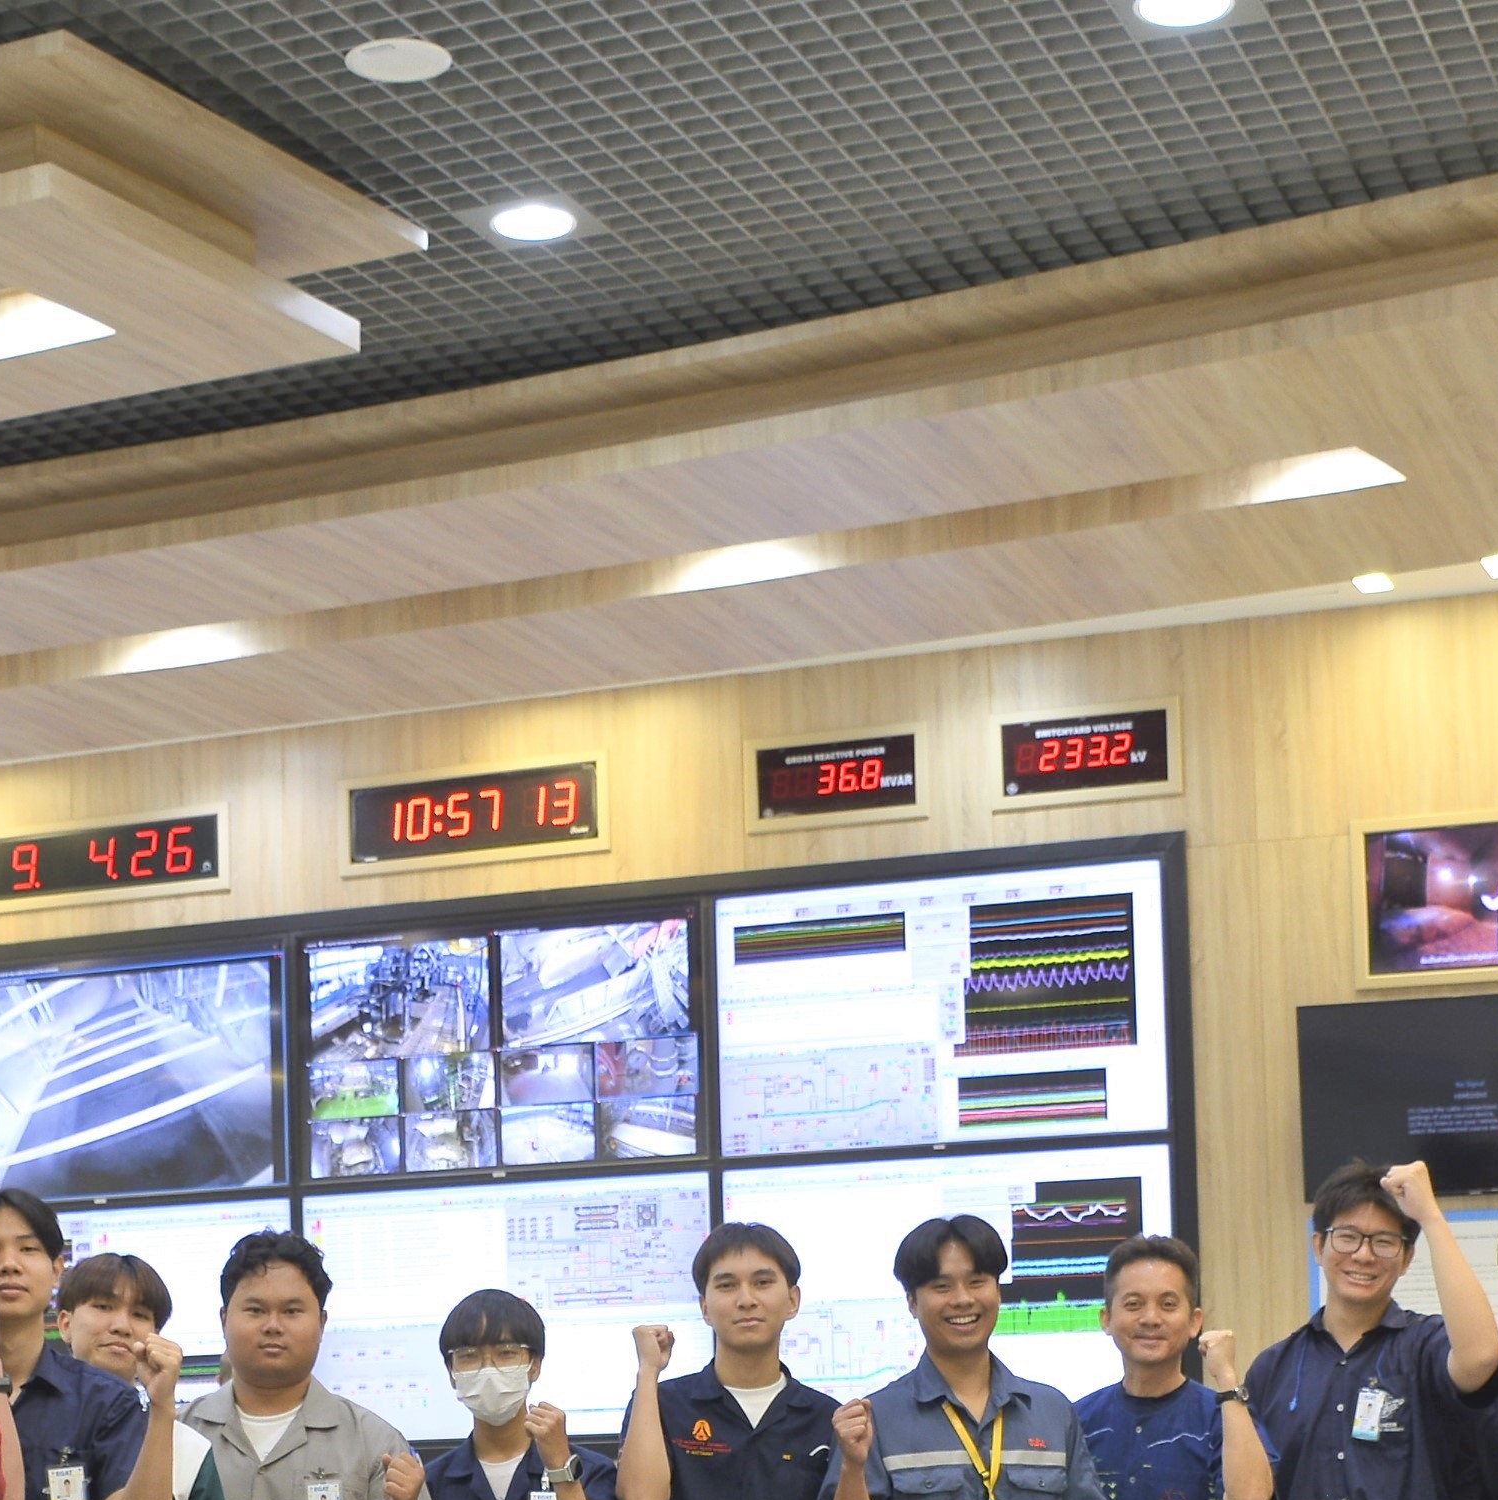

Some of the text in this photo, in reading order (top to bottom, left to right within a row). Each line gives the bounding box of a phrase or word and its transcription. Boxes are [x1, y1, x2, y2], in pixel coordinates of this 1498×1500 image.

[1035, 721, 1133, 739] SWITCHYARD VOLTAGE
[785, 746, 886, 765] GROSS REACTIVE POWER
[1038, 732, 1147, 773] 233.2 kV
[817, 758, 913, 796] 36.8 MVAR
[392, 780, 579, 842] 10:57 13
